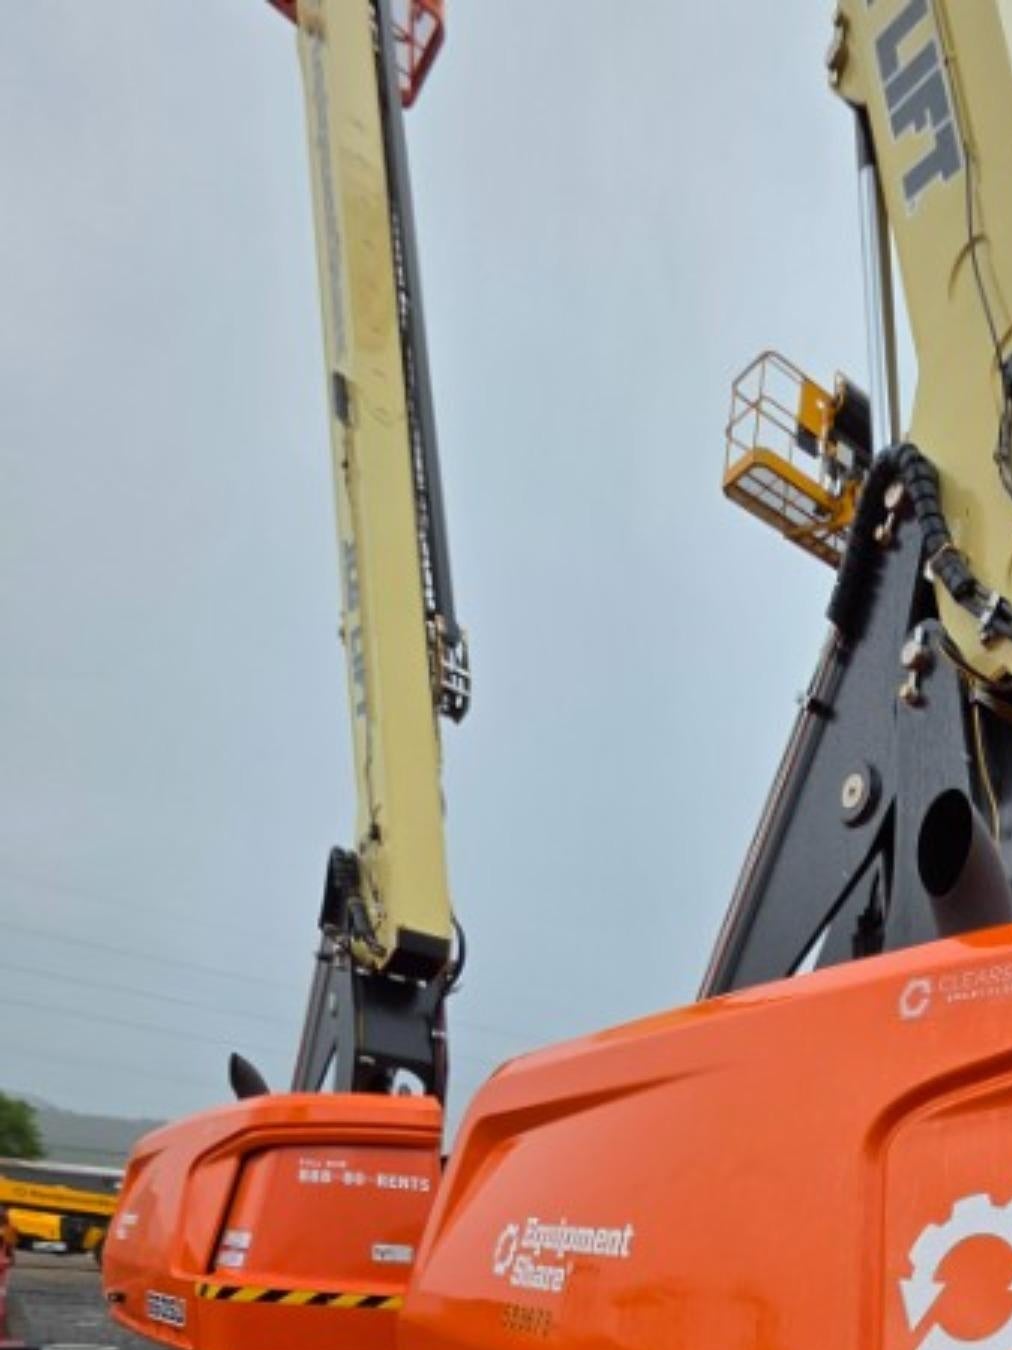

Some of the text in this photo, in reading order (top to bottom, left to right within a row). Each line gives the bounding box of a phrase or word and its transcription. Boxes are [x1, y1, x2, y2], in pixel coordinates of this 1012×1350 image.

[873, 0, 965, 202] LIFT
[520, 1216, 635, 1260] Equipment
[509, 1252, 566, 1293] Share
